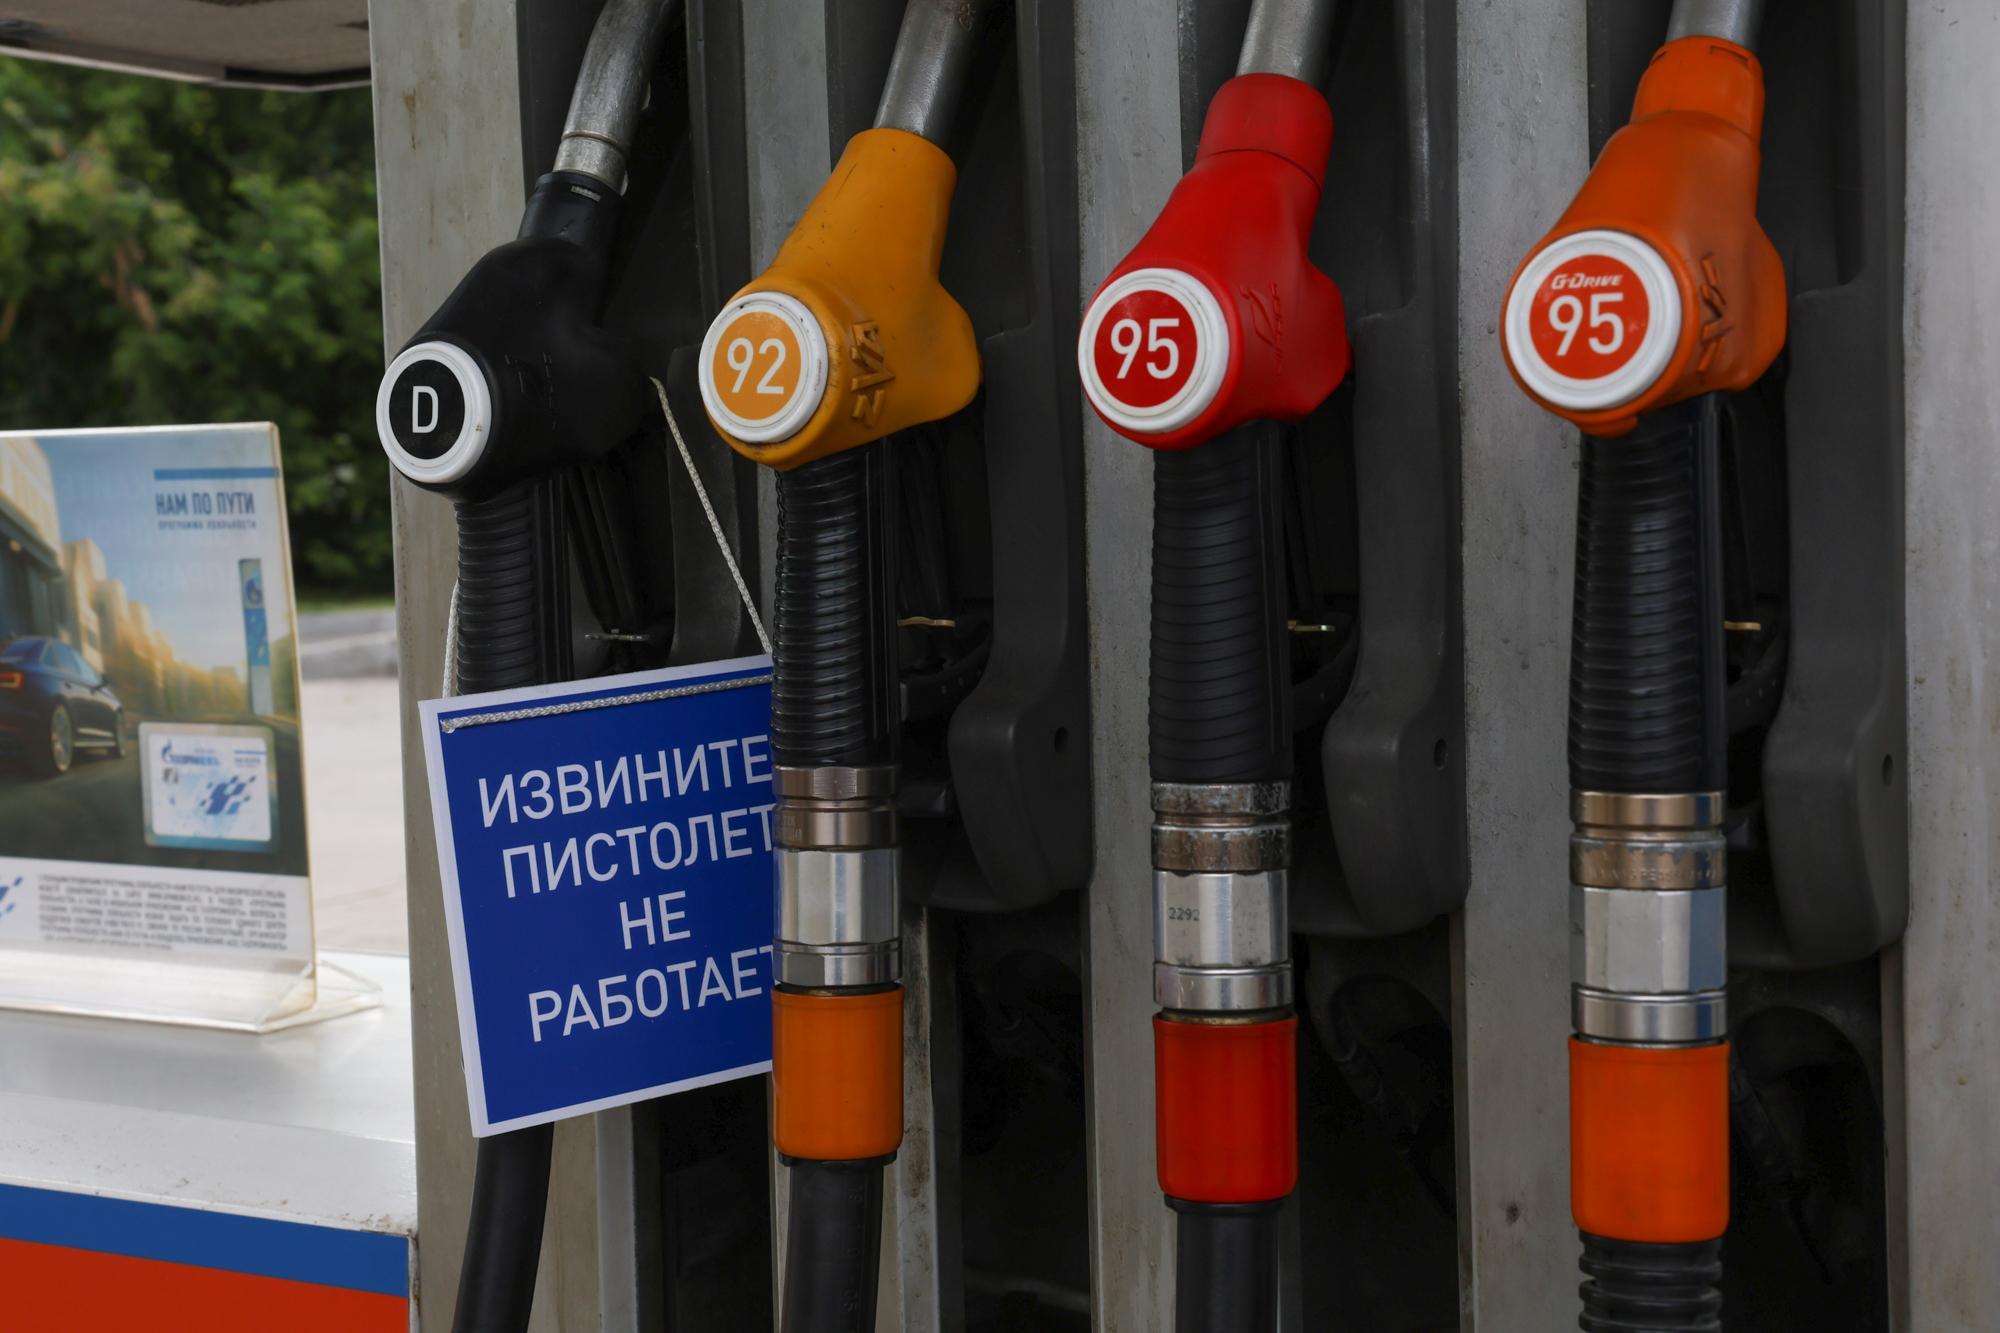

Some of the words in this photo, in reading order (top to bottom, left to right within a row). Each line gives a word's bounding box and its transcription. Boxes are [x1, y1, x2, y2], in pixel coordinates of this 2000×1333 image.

[1110, 318, 1180, 379] 95
[1548, 292, 1624, 356] 95
[726, 338, 786, 395] 92
[411, 385, 439, 433] D
[155, 492, 188, 515] НАМ
[192, 492, 212, 515] ПО
[216, 491, 256, 515] ПУТИ
[478, 734, 772, 829] ИЗВИНИТЕ
[502, 803, 776, 898] ПИСТОЛЕТ
[619, 890, 691, 950] НЕ
